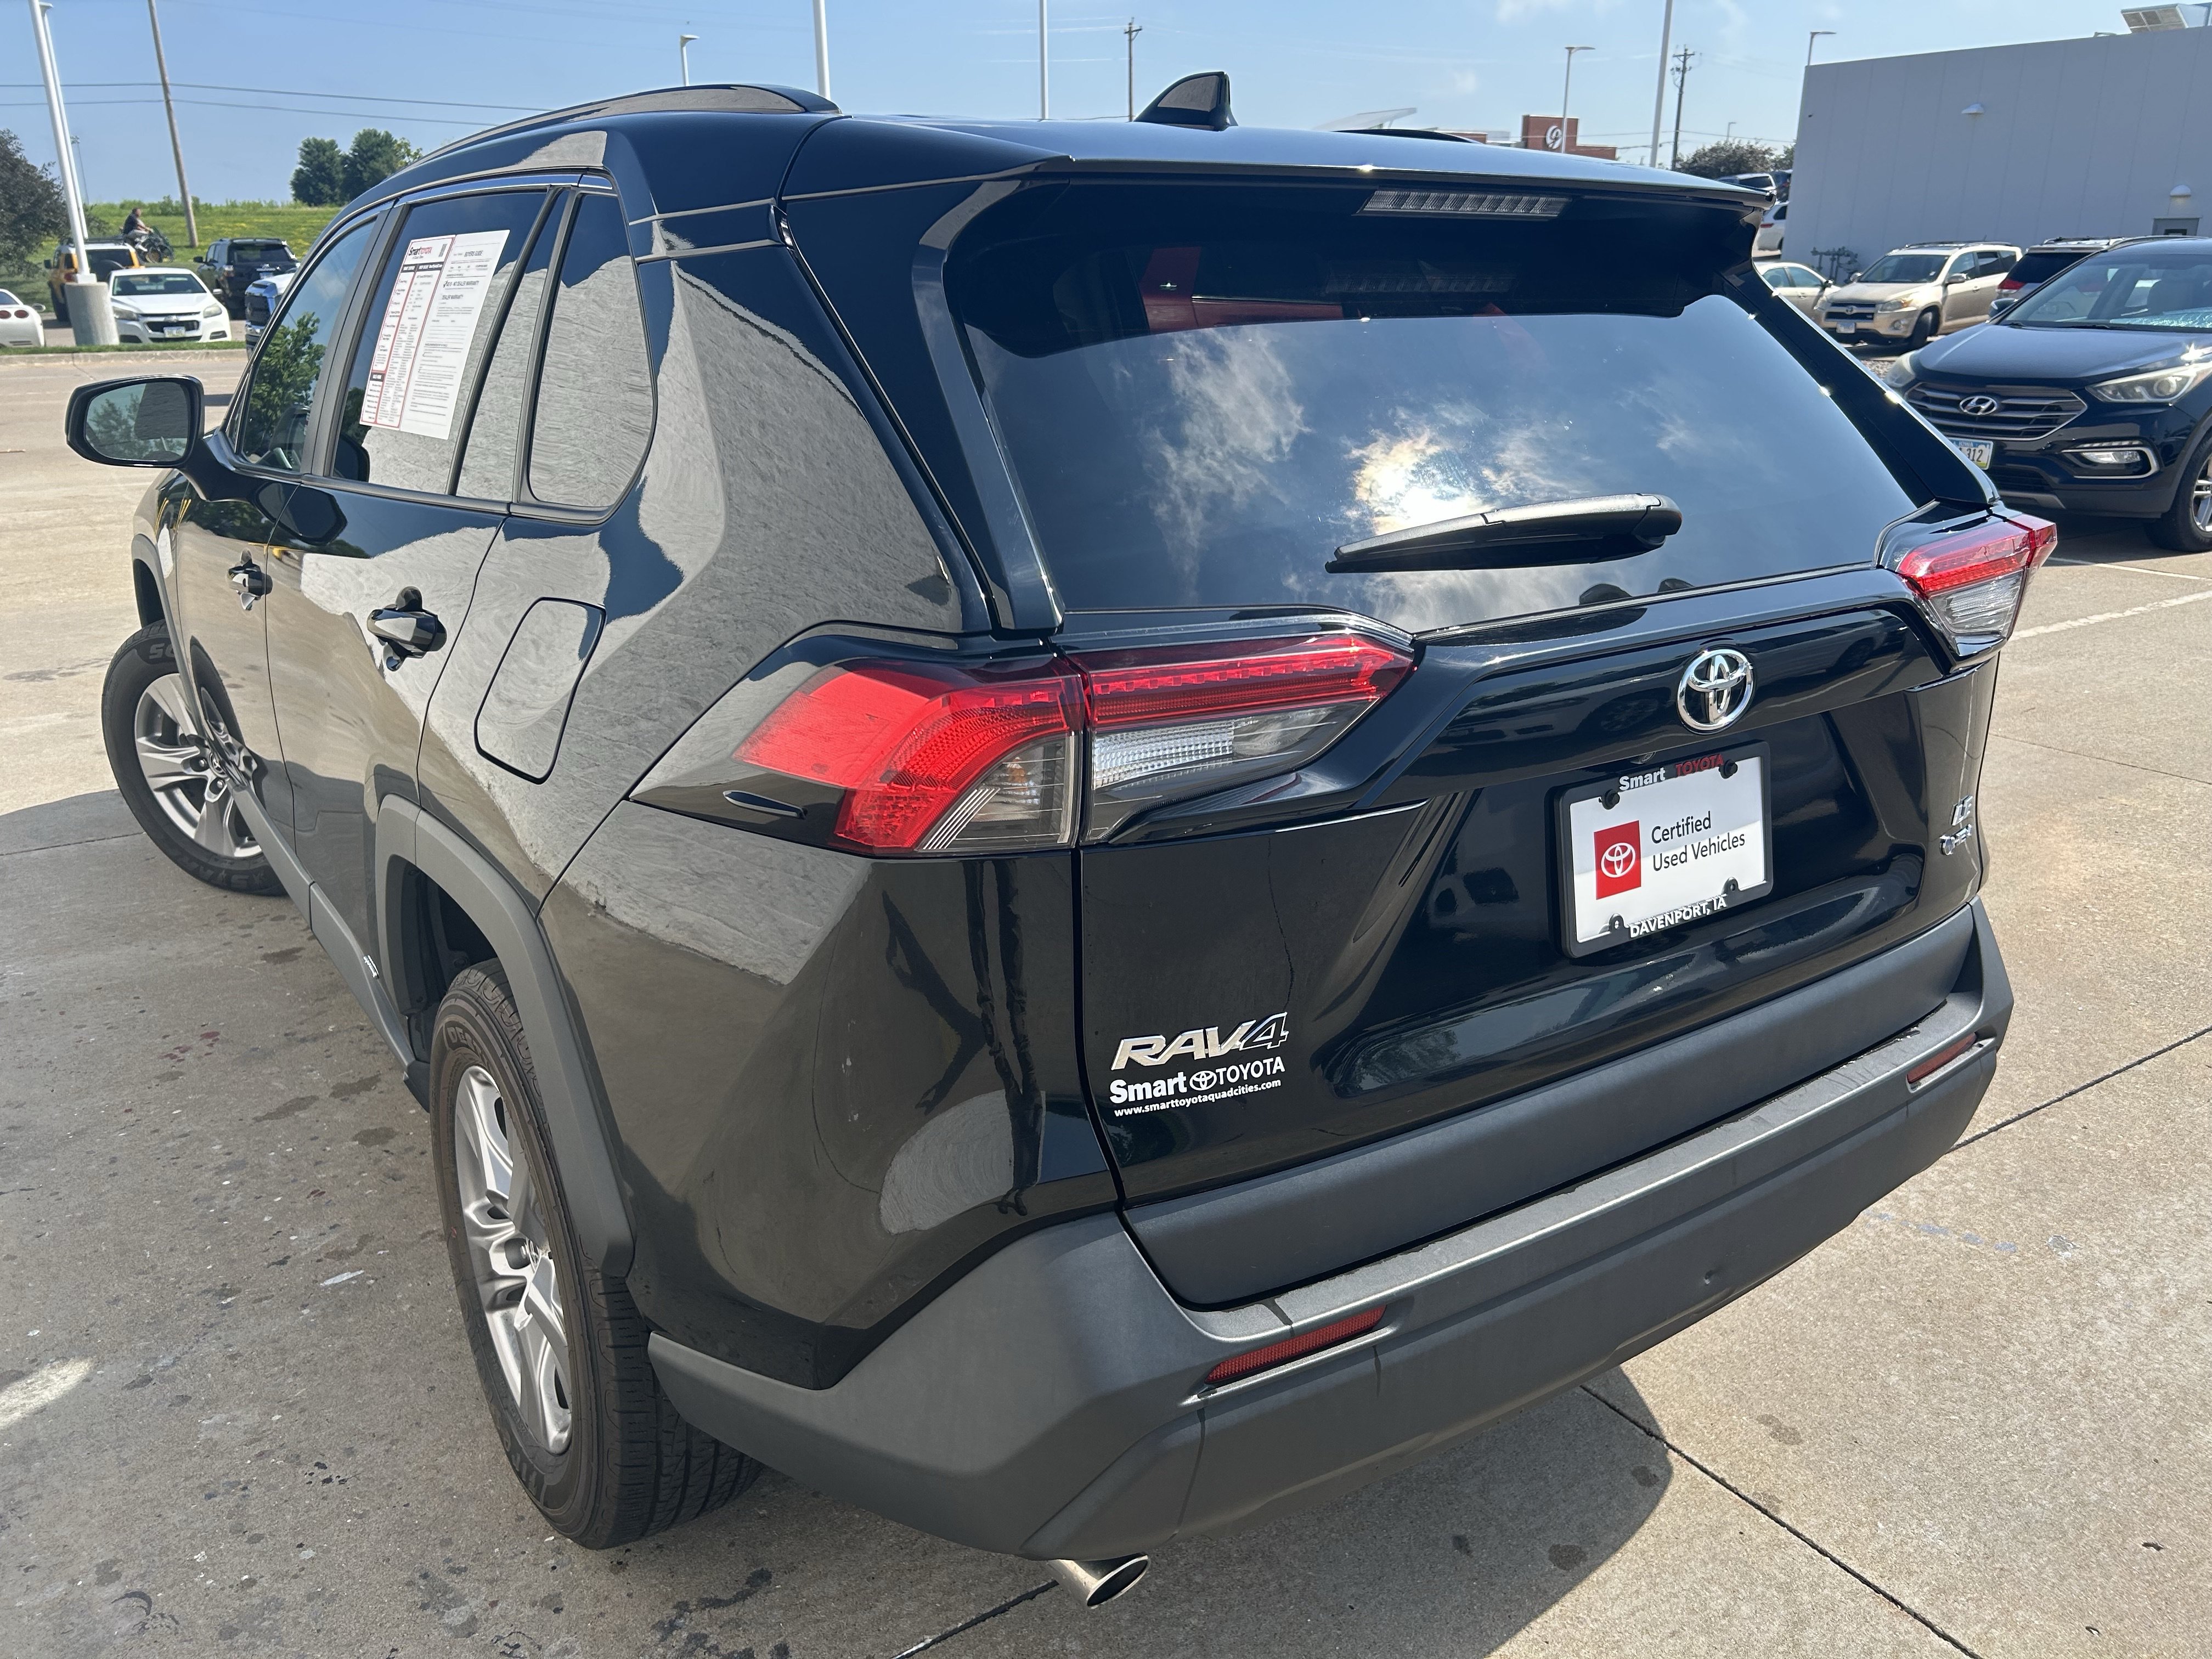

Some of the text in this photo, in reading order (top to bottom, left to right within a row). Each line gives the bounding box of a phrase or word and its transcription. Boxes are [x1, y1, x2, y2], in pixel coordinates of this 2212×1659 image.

[1619, 754, 1724, 791] Smart TOYOTA
[1651, 811, 1712, 844] Certified
[1652, 833, 1745, 872] Used Vehicles
[1630, 895, 1727, 938] DAVENPORT, IA
[1110, 1011, 1289, 1071] RAV4
[1109, 1056, 1285, 1103] Smart TOYOTA
[1114, 1079, 1282, 1117] www.smarttoyotaquadcities.com
